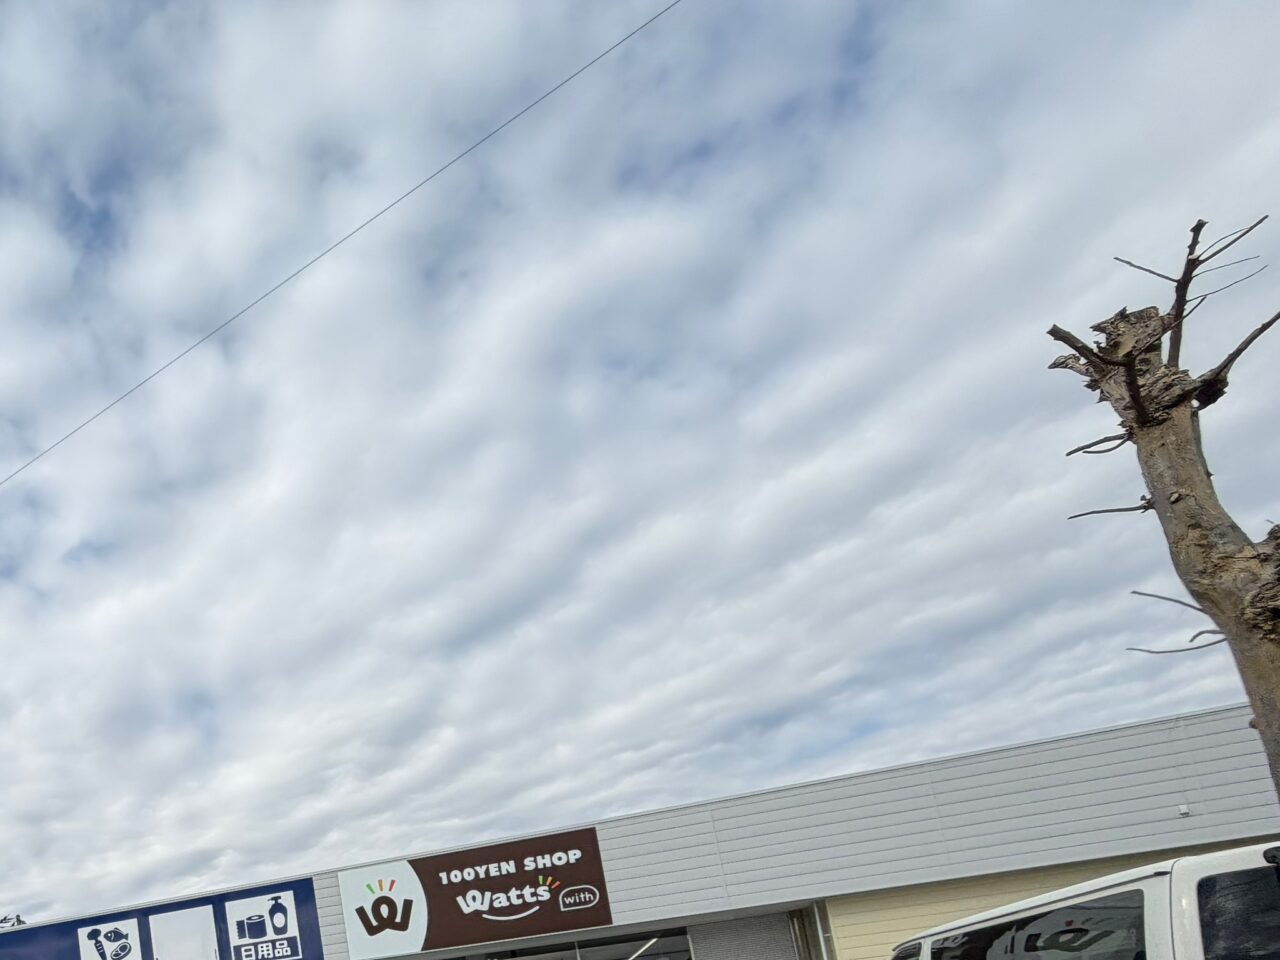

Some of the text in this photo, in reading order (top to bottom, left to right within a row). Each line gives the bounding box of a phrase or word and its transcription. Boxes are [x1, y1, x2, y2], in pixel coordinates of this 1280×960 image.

[439, 849, 582, 885] 100YEN SHOP
[456, 883, 551, 914] Watts
[564, 889, 594, 905] with
